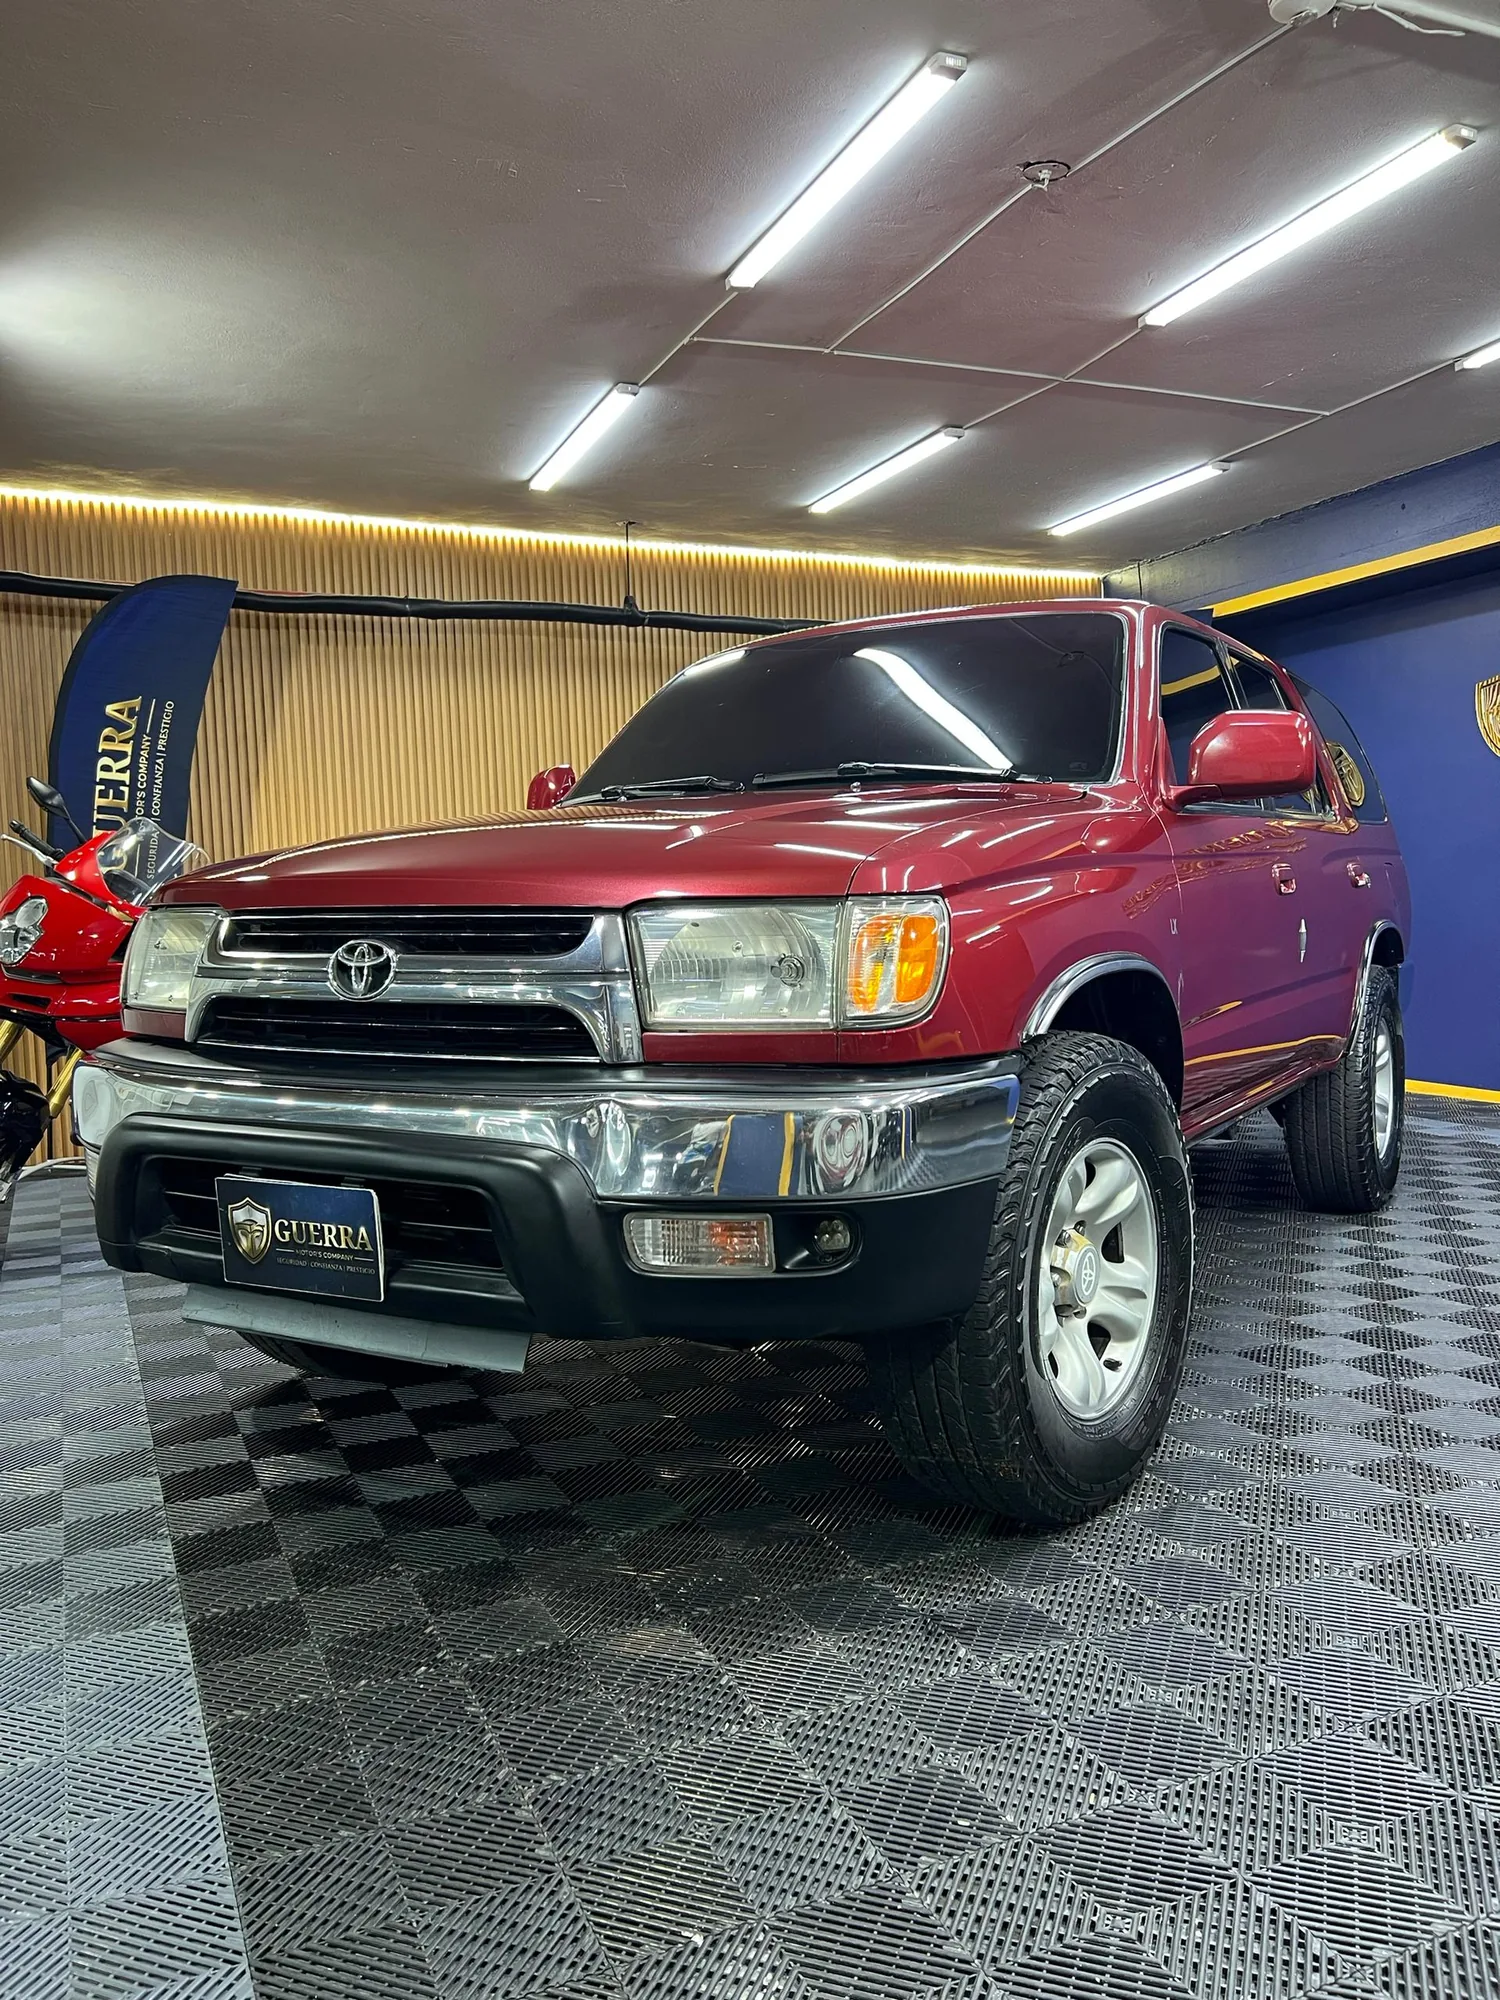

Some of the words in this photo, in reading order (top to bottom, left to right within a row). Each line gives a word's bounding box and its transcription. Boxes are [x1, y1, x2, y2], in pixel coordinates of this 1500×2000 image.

[157, 701, 175, 752] PRESTIGIO
[138, 733, 152, 789] COMPANY
[152, 758, 165, 816] CONFIANZA
[147, 826, 160, 880] SEGURIDA
[274, 1218, 374, 1252] GUERRA
[322, 1251, 354, 1262] COMPANY
